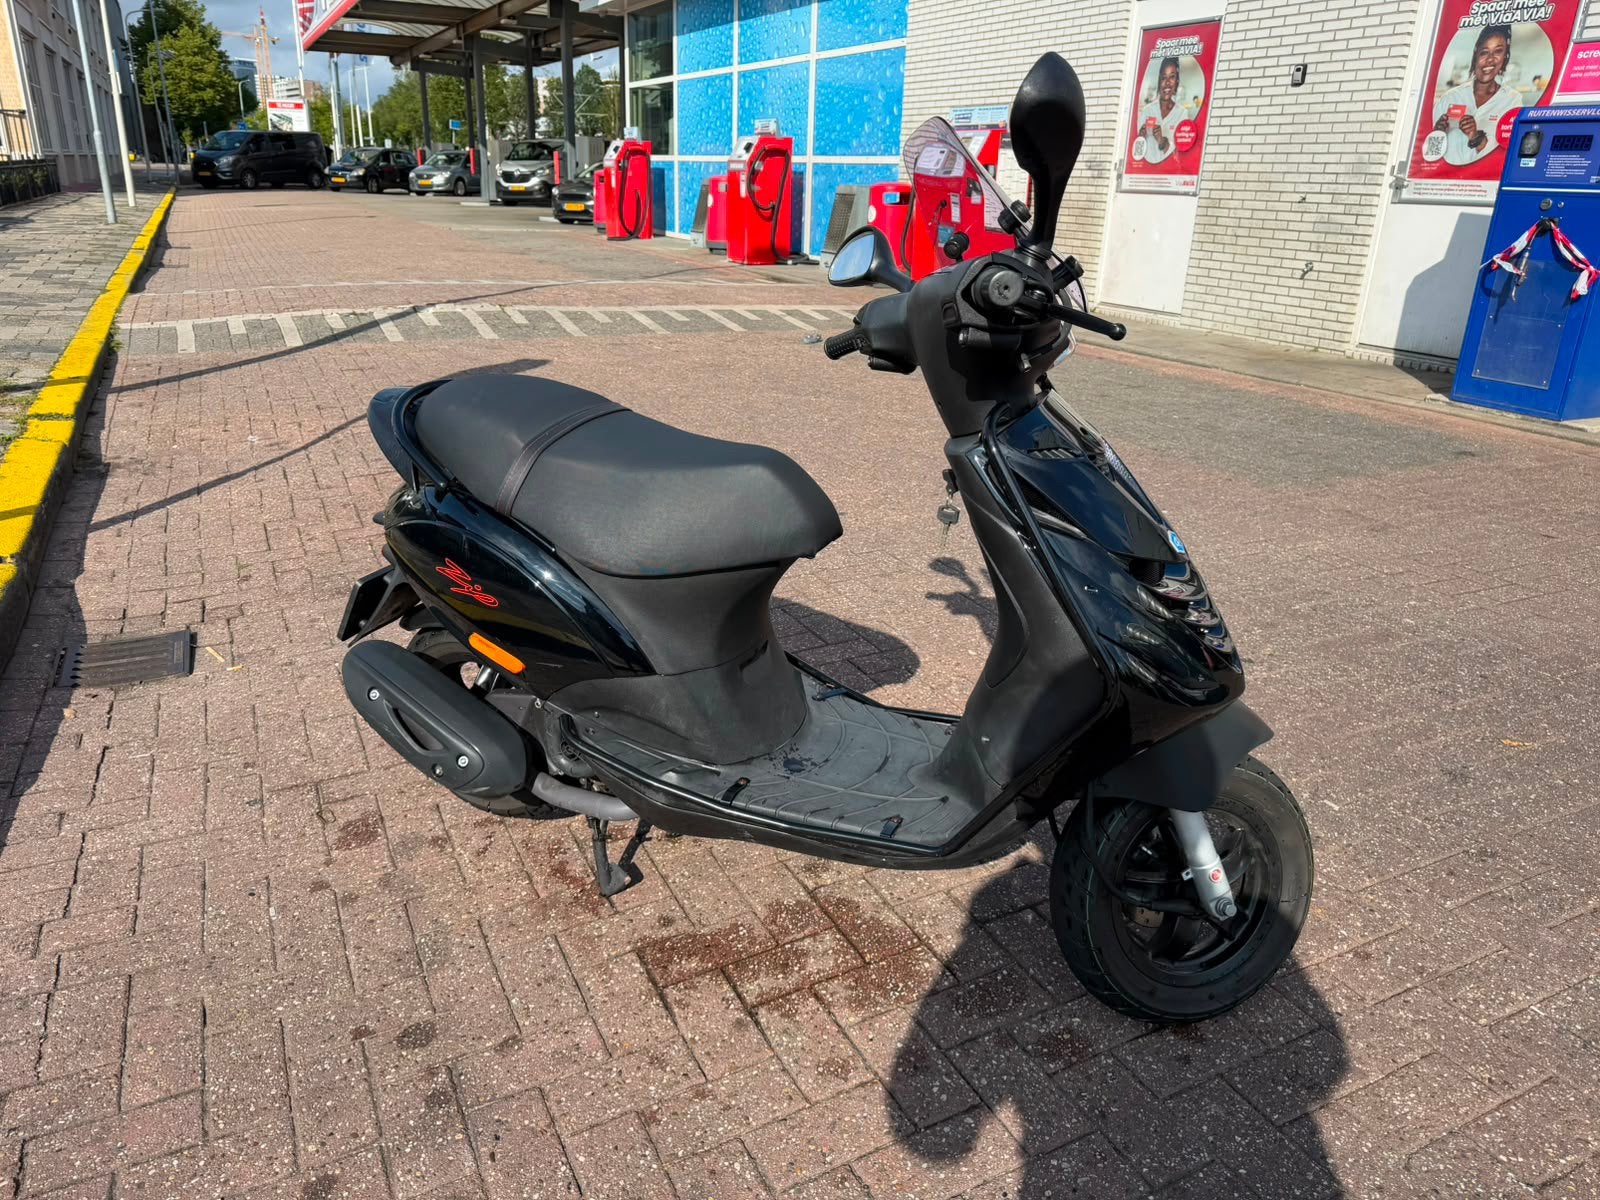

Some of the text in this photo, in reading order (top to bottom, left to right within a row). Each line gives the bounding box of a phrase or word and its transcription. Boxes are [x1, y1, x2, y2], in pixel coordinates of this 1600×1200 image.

[1471, 0, 1513, 15] Spaar
[1459, 5, 1554, 28] met ViaAVIA!
[1150, 43, 1203, 59] met ViaAVIA!
[1155, 36, 1199, 50] Spaar mee
[435, 558, 499, 607] Zip
